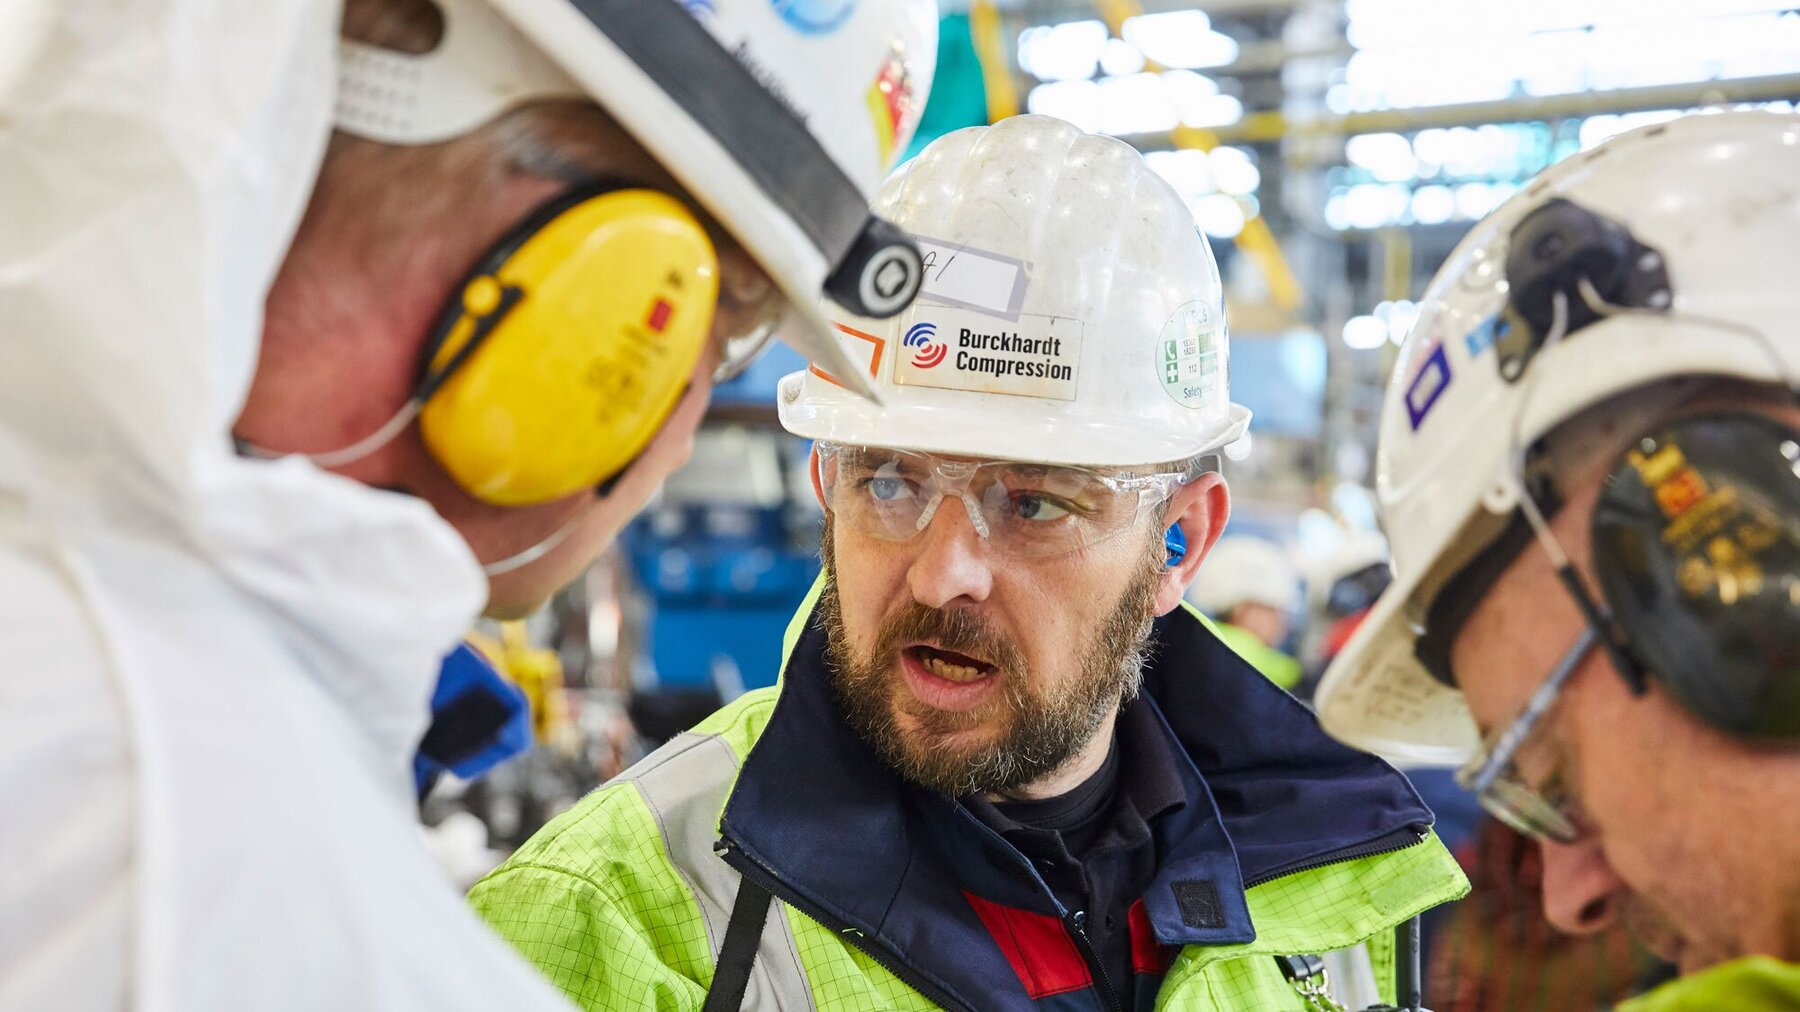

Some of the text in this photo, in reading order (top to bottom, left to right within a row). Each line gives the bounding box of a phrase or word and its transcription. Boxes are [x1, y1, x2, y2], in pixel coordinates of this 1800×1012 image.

[959, 328, 1061, 356] Burckhardt
[956, 351, 1072, 380] Compression
[1188, 364, 1198, 374] 112
[1183, 386, 1202, 399] Safety
